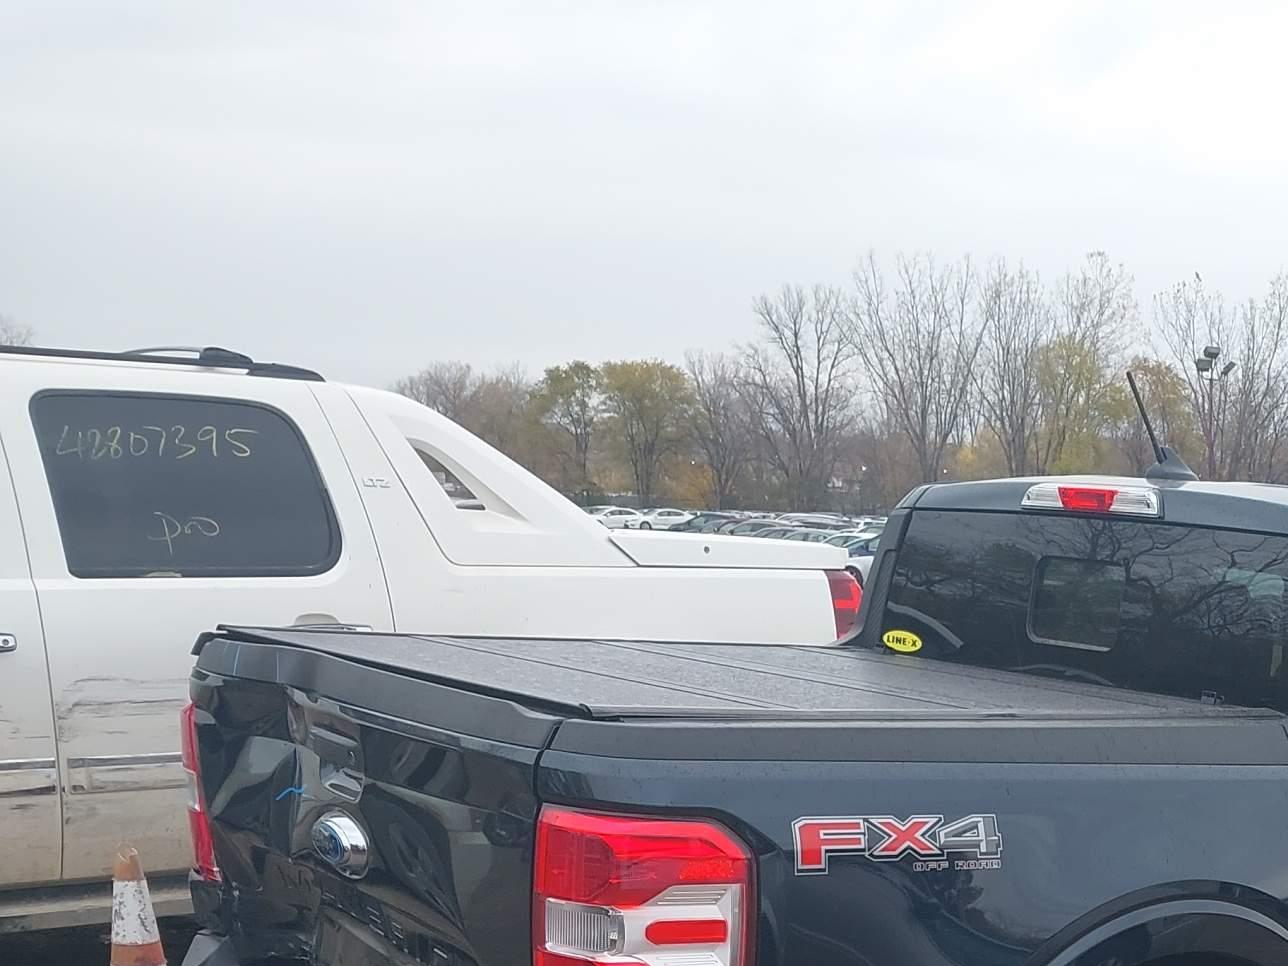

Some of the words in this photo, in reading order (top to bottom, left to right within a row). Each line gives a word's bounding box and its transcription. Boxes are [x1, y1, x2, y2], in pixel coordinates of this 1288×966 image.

[791, 813, 1003, 876] FX4
[912, 861, 949, 872] OFF
[954, 859, 1002, 870] ROAD
